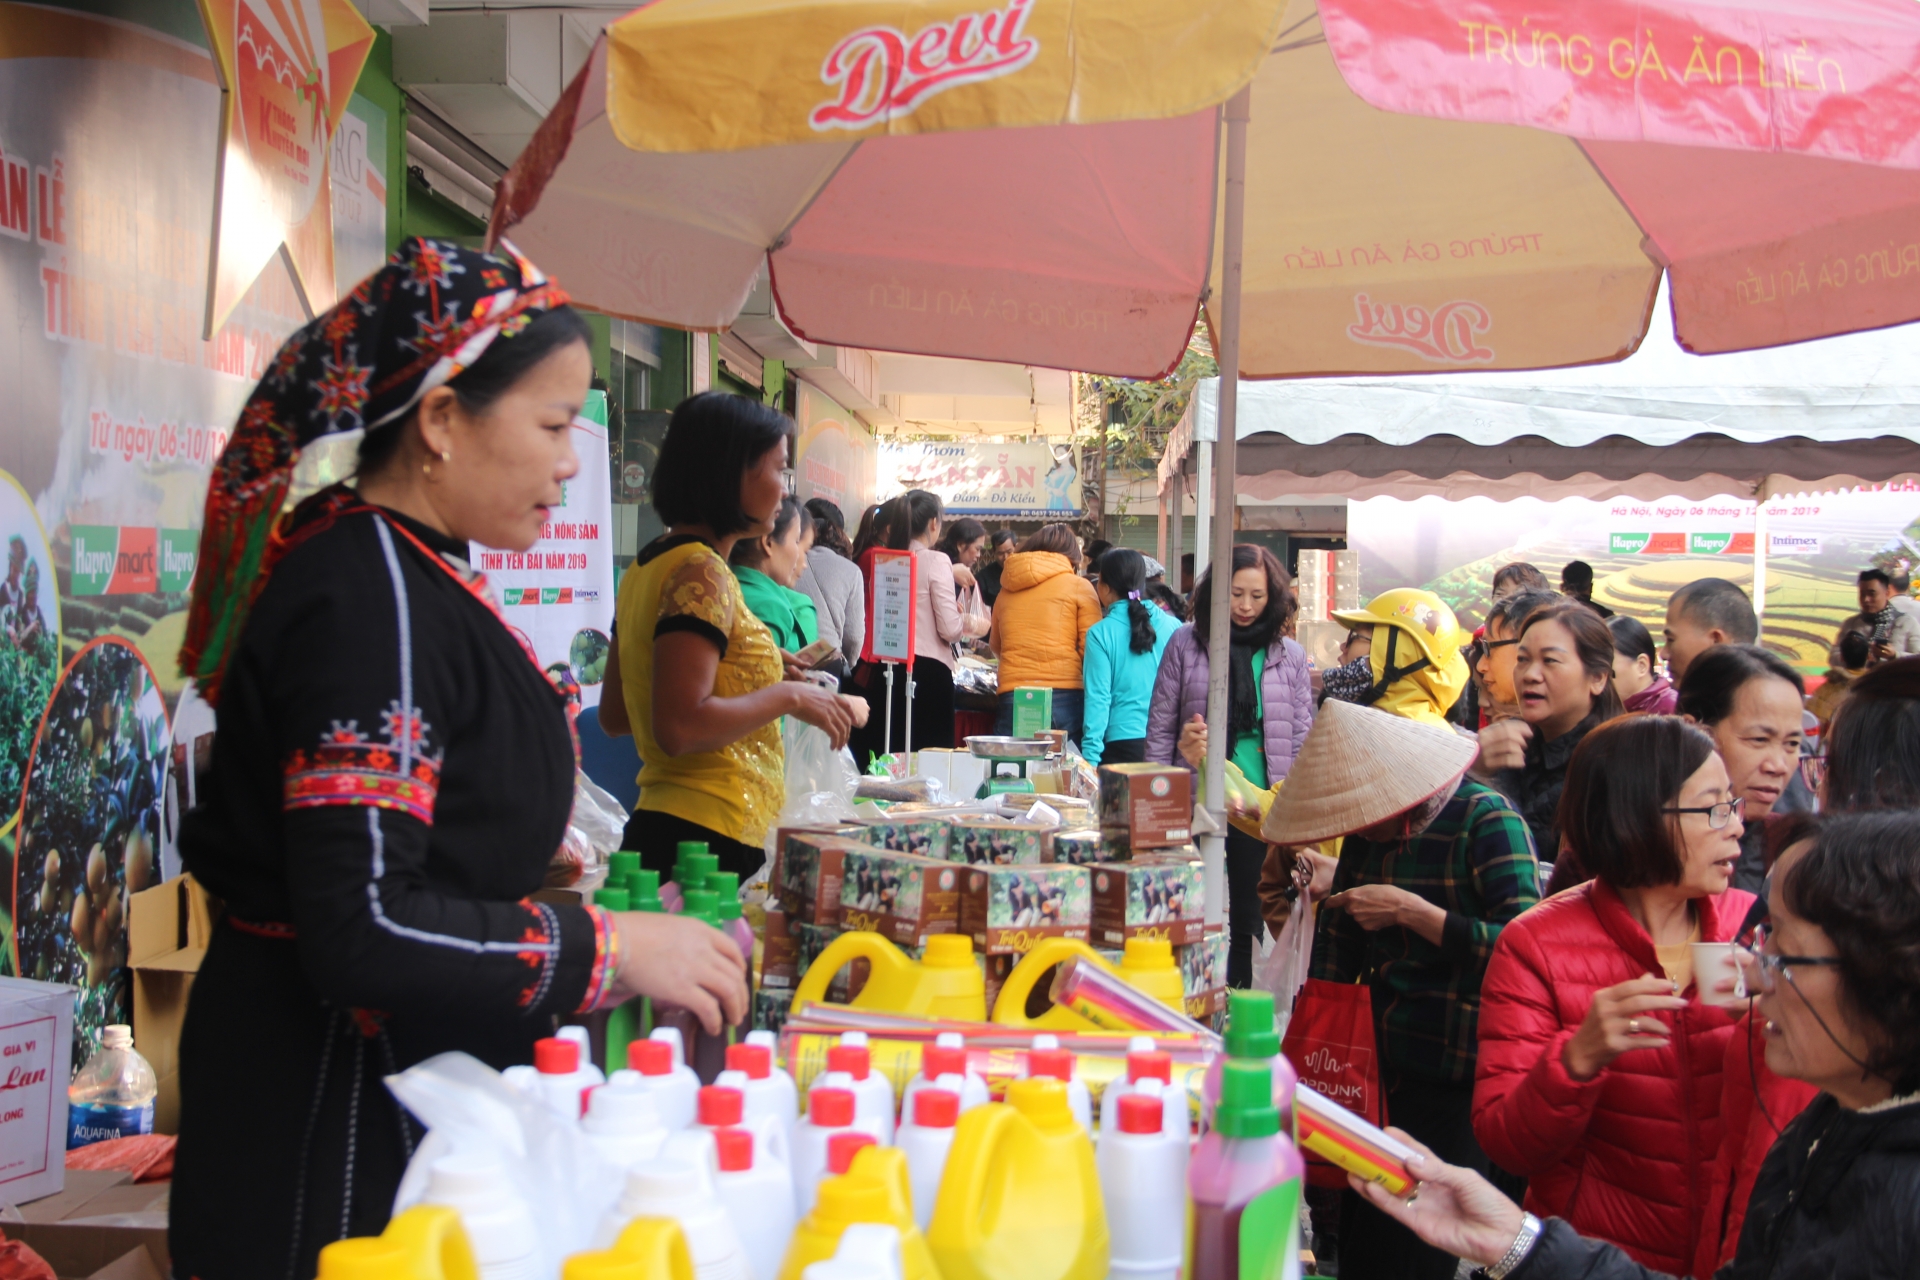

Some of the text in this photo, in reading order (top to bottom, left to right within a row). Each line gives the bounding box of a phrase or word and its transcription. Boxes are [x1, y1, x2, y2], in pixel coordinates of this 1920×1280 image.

[1608, 28, 1668, 81] GÀ
[328, 122, 363, 184] RG
[1689, 507, 1704, 516] 06
[1791, 507, 1820, 516] 2019
[1612, 534, 1645, 551] Hapro
[1693, 534, 1725, 550] Hapro
[1772, 534, 1818, 546] Intimex
[75, 537, 113, 584] Hapro
[164, 538, 195, 581] Hapro
[567, 551, 587, 570] 2019
[3, 1043, 22, 1057] GIA
[1298, 1077, 1363, 1099] OPDUNK
[73, 1123, 122, 1140] AQUAFINA
